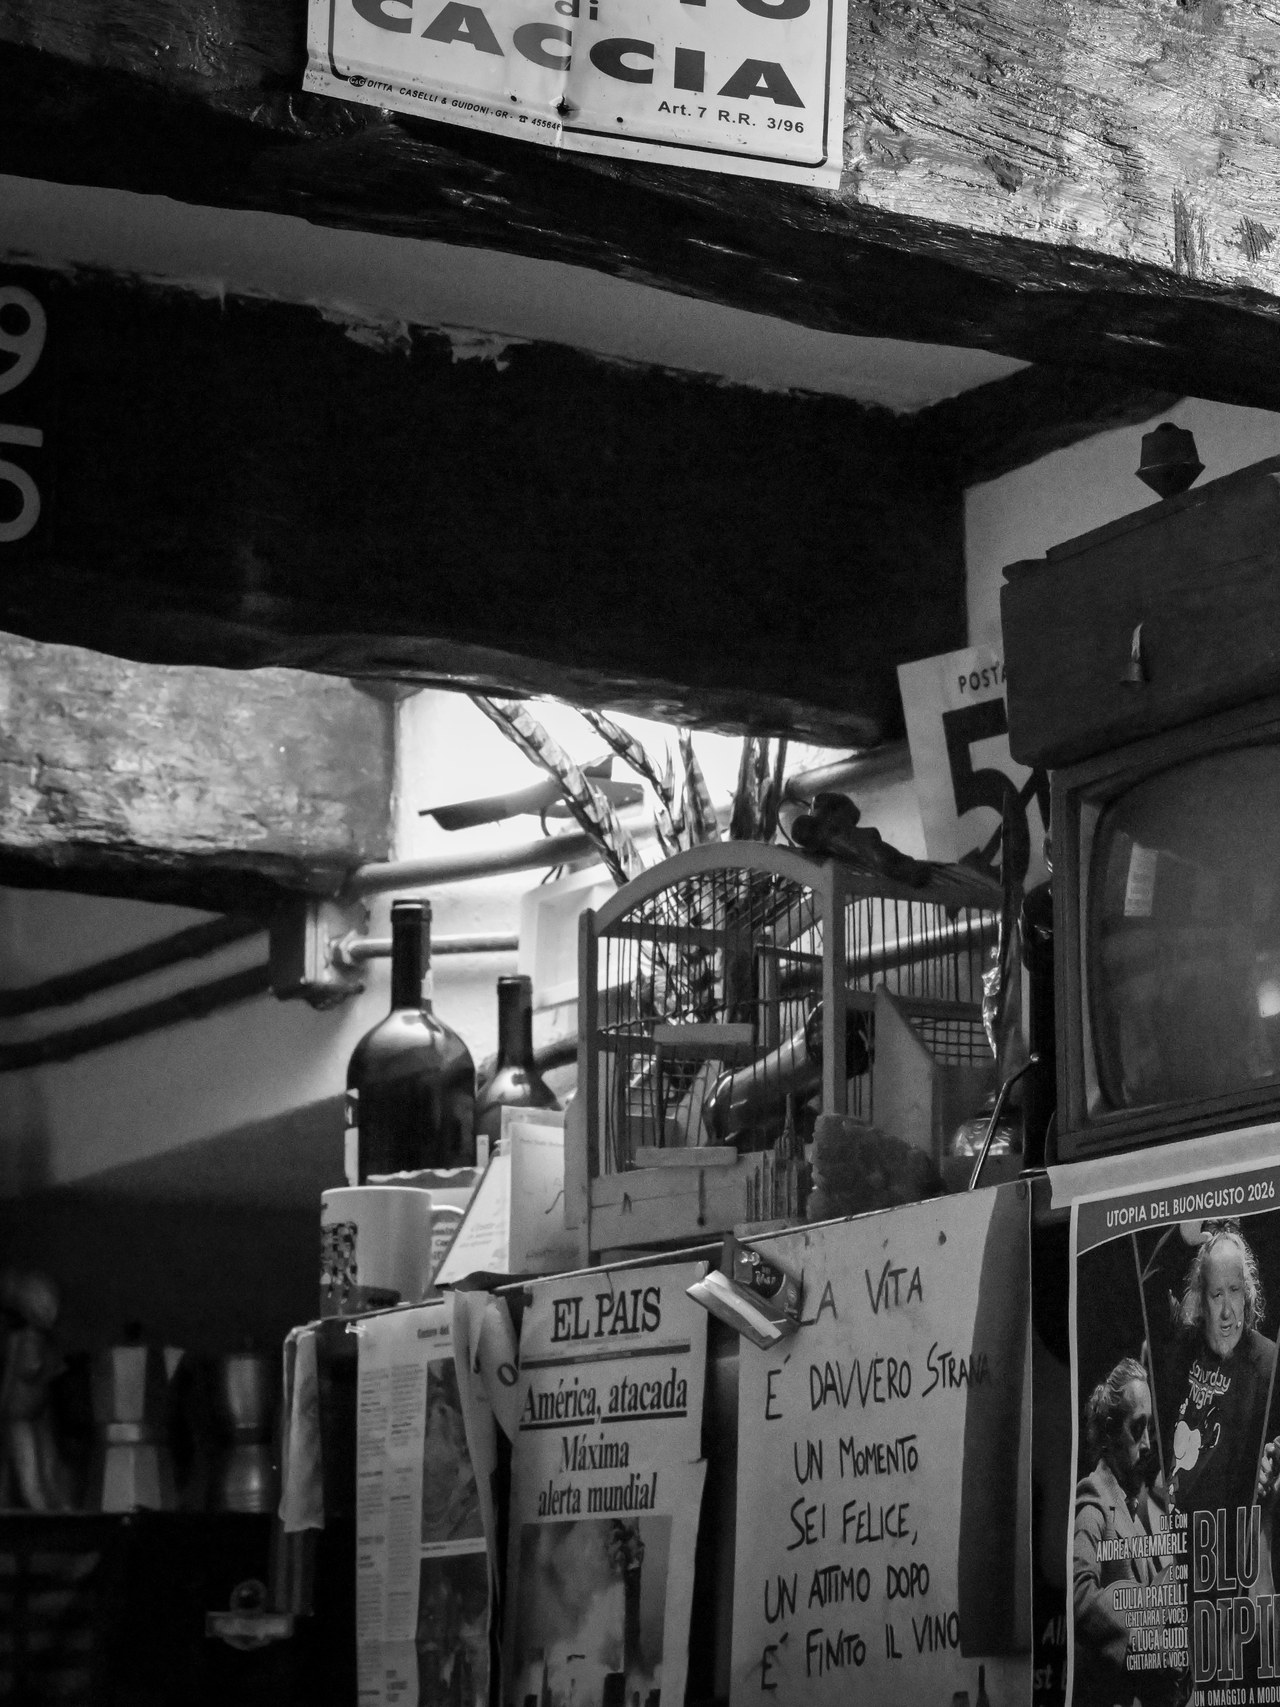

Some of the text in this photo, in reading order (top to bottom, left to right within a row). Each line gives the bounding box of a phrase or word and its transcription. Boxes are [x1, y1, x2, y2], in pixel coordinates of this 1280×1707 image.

[352, 0, 806, 109] CACCIA
[367, 79, 393, 93] DITTA
[399, 87, 437, 103] CASELLI
[441, 97, 447, 105] &
[658, 101, 804, 133] Art. 7 R.R. 3/96
[1106, 1205, 1147, 1228] UTOPIA
[1150, 1200, 1170, 1220] DEL
[1173, 1186, 1244, 1216] BUONGUSTO
[1247, 1181, 1275, 1202] 2026
[865, 1259, 923, 1315] VITA
[551, 1287, 661, 1343] EL PAIS
[520, 1367, 688, 1422] América, atacada
[809, 1356, 912, 1411] DAVVERO
[560, 1433, 630, 1473] Máxima
[794, 1434, 919, 1485] UN MOMENTO
[538, 1472, 657, 1517] alerta mundial
[787, 1497, 919, 1552] SEI FELICE,
[1175, 1513, 1188, 1530] CON
[1096, 1532, 1188, 1563] ANDREA KAEMMERLE
[1193, 1504, 1262, 1593] BLU
[764, 1563, 930, 1625] UN ATTIMO DOPO
[1169, 1564, 1189, 1580] E CON
[1113, 1583, 1189, 1611] GIULIA PRATELLI
[1125, 1606, 1189, 1628] (CHITARRA E VOCE)
[805, 1611, 960, 1678] FINITO IL VINO
[1126, 1649, 1189, 1671] (CHITARRA E VOCE)
[1136, 1626, 1189, 1650] LUCA GUIDI
[1194, 1690, 1206, 1707] UN
[1207, 1687, 1246, 1707] OMAGGIO
[1249, 1687, 1255, 1704] A
